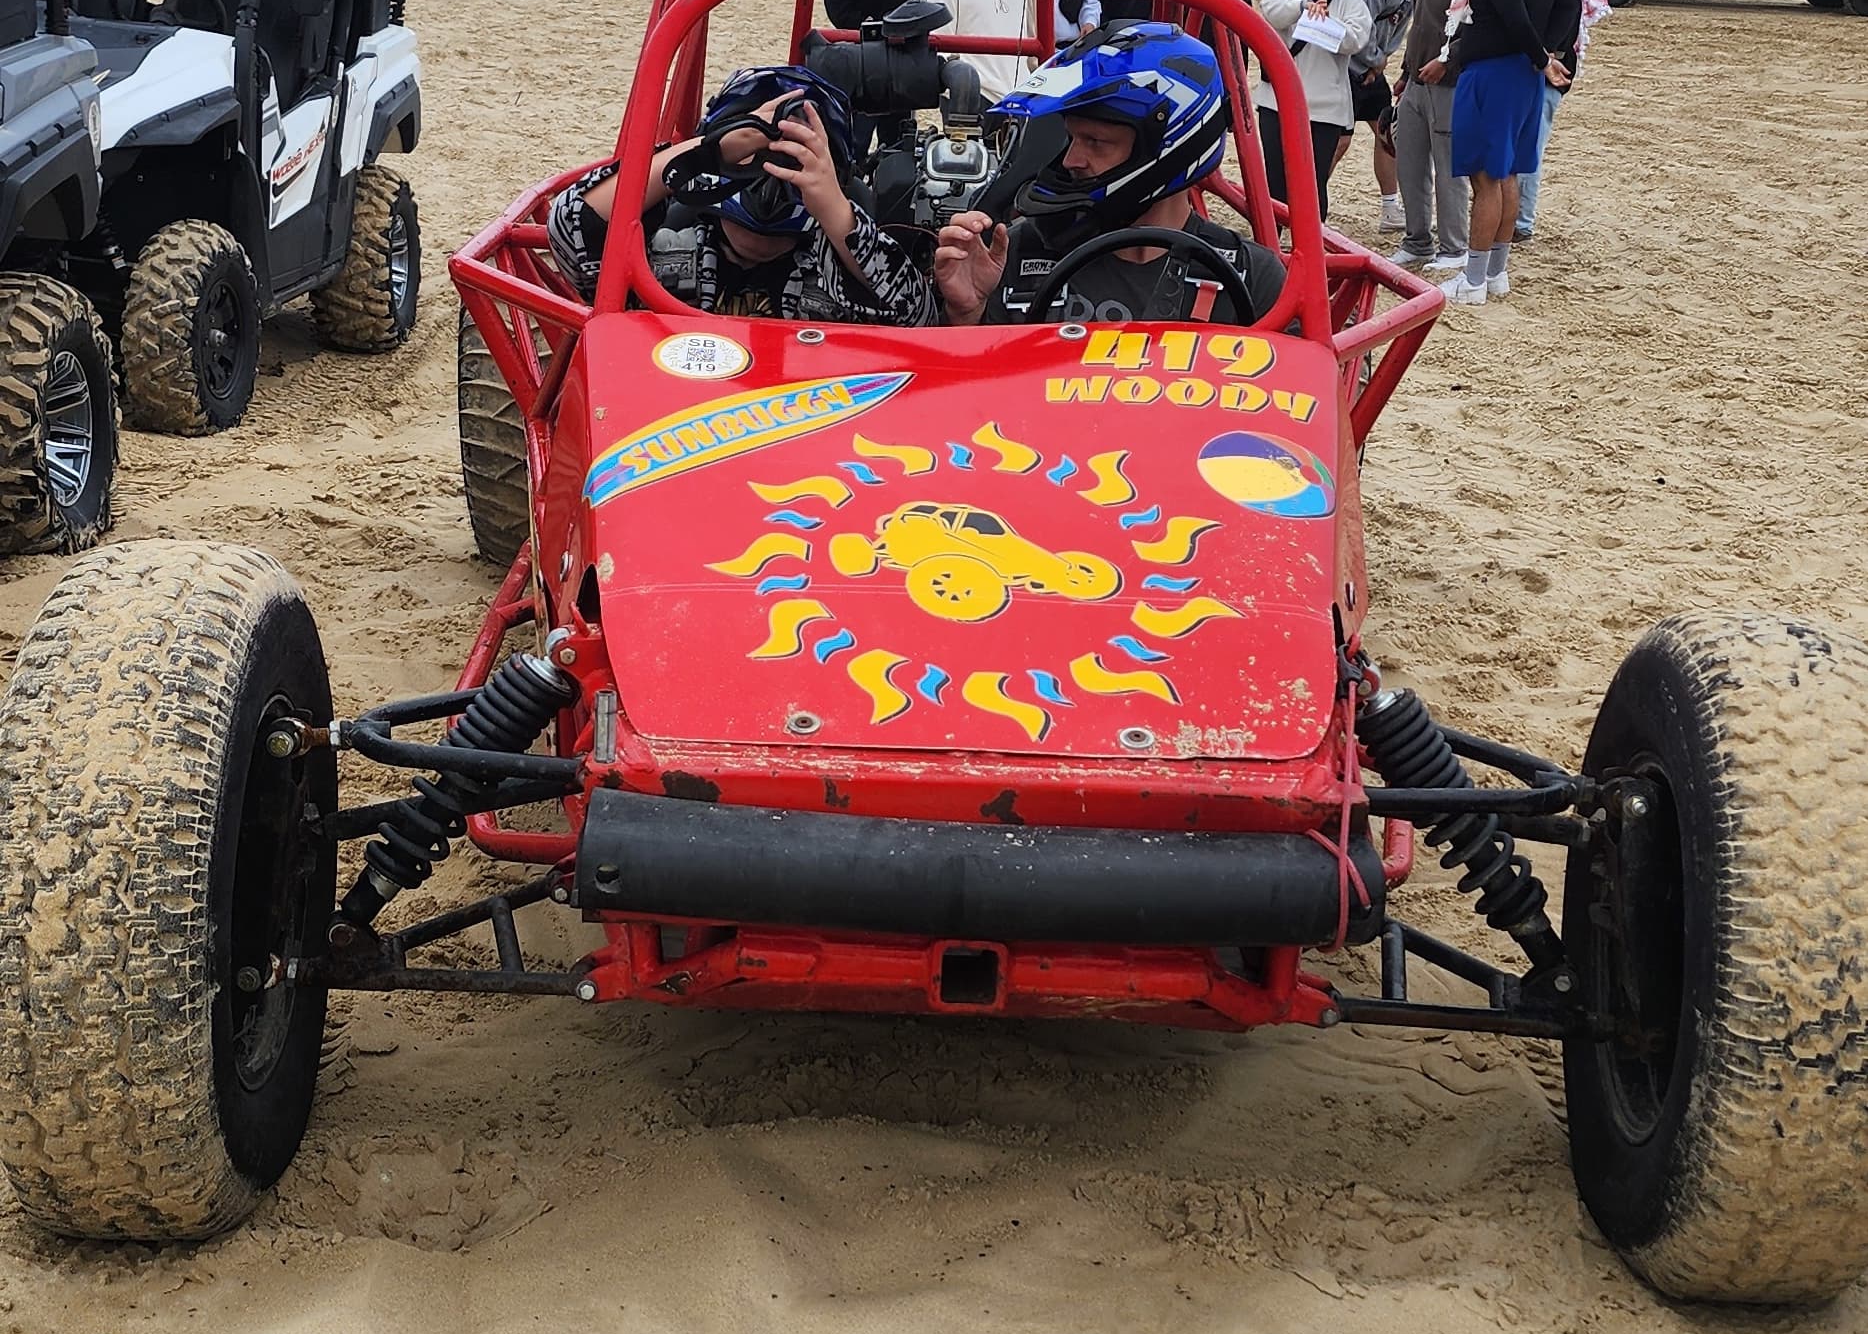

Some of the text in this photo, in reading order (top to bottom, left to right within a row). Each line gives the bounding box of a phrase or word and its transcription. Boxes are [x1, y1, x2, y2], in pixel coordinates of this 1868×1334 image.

[681, 362, 716, 372] 419
[688, 338, 716, 348] SB
[1080, 329, 1276, 378] 419
[1045, 375, 1320, 423] WOODY
[618, 381, 855, 474] SUNBUGGY
